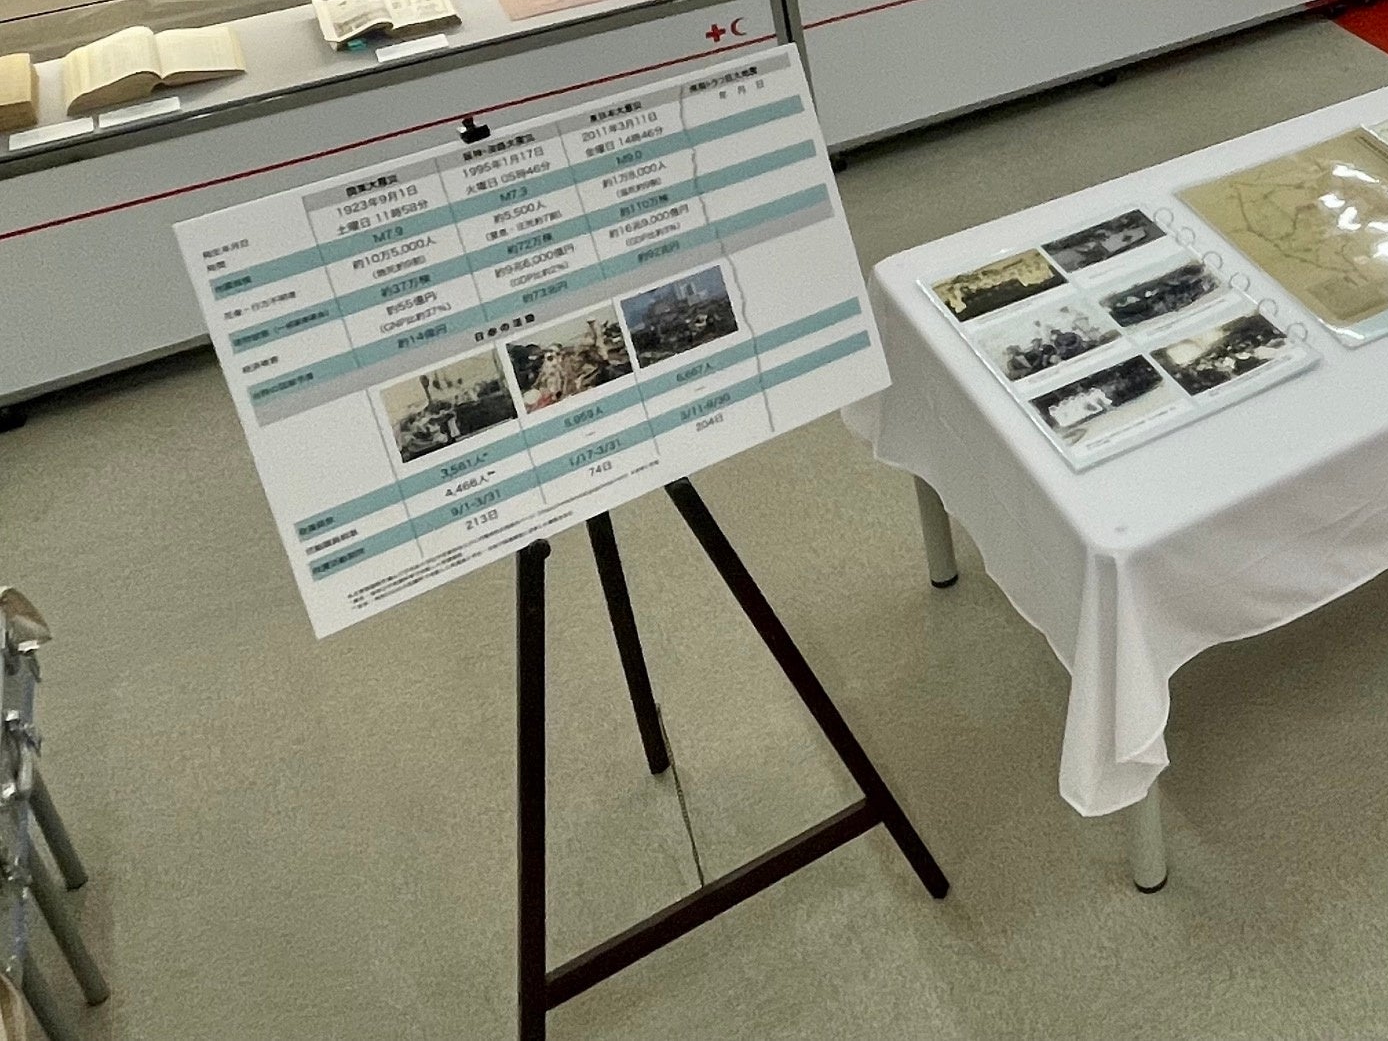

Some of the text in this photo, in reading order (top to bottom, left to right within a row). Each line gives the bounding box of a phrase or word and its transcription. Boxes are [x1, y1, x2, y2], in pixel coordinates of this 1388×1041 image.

[336, 211, 372, 236] 土曜日
[465, 175, 499, 196] 火曜日
[500, 160, 552, 184] 05時46分
[617, 125, 664, 149] 14時46分
[337, 184, 418, 217] 1923年9月1日
[463, 146, 545, 179] 1995年1月17日
[581, 112, 658, 143] 2011年3月11日
[353, 235, 437, 271] 約10万5,000人
[465, 508, 499, 530] 213日
[589, 460, 613, 477] 74日
